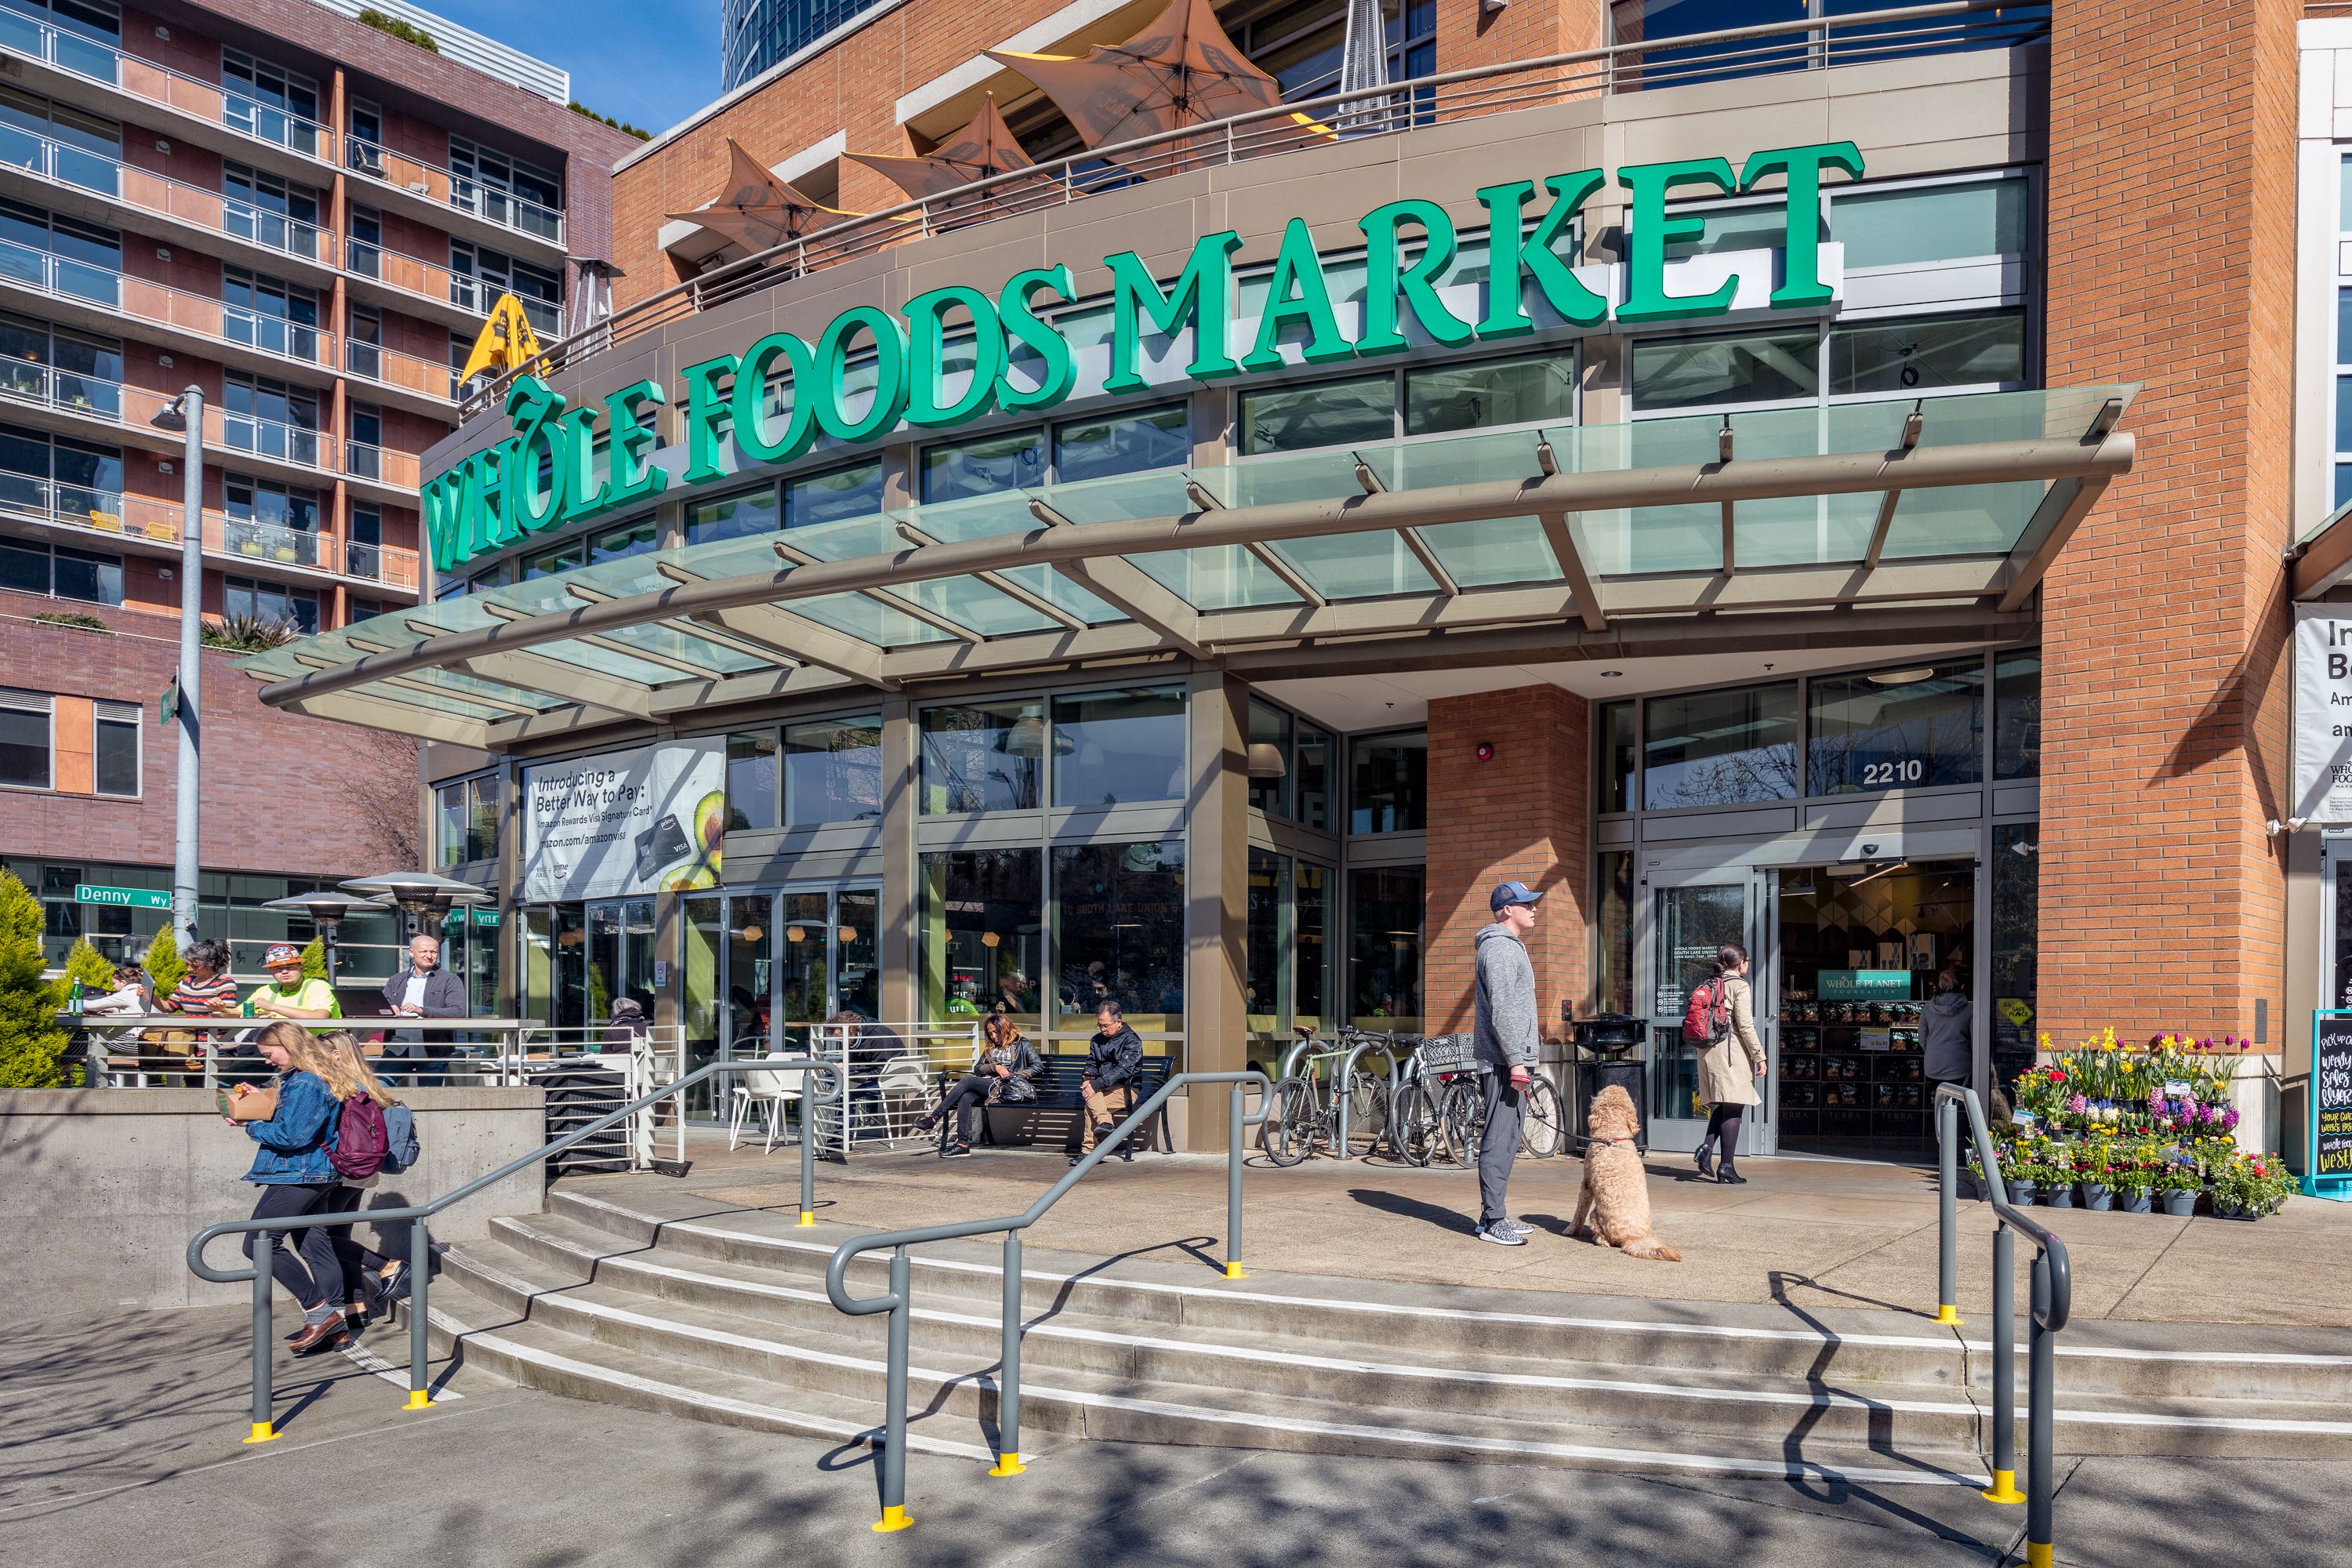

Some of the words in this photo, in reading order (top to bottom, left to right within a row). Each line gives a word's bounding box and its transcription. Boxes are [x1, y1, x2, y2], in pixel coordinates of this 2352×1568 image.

[419, 373, 668, 573] WHOLE
[681, 263, 1078, 485] FOODS
[1102, 140, 1866, 395] MARKET
[539, 768, 604, 793] Introducing
[608, 770, 615, 782] a
[1864, 760, 1922, 784] 2210
[537, 795, 571, 812] Better
[574, 790, 599, 809] Way
[603, 789, 615, 804] to
[618, 784, 644, 804] Pay:
[562, 816, 587, 826] Rewards
[589, 814, 601, 823] Visa
[601, 811, 632, 822] Signature
[661, 818, 673, 829] prime
[539, 829, 626, 849] amazon.com/amazonvisa
[673, 843, 688, 852] VISA
[554, 862, 568, 873] prime
[82, 887, 132, 904] Denny
[151, 895, 167, 906] Wy
[1826, 975, 1860, 988] WHOLE
[1864, 979, 1903, 988] PLANET
